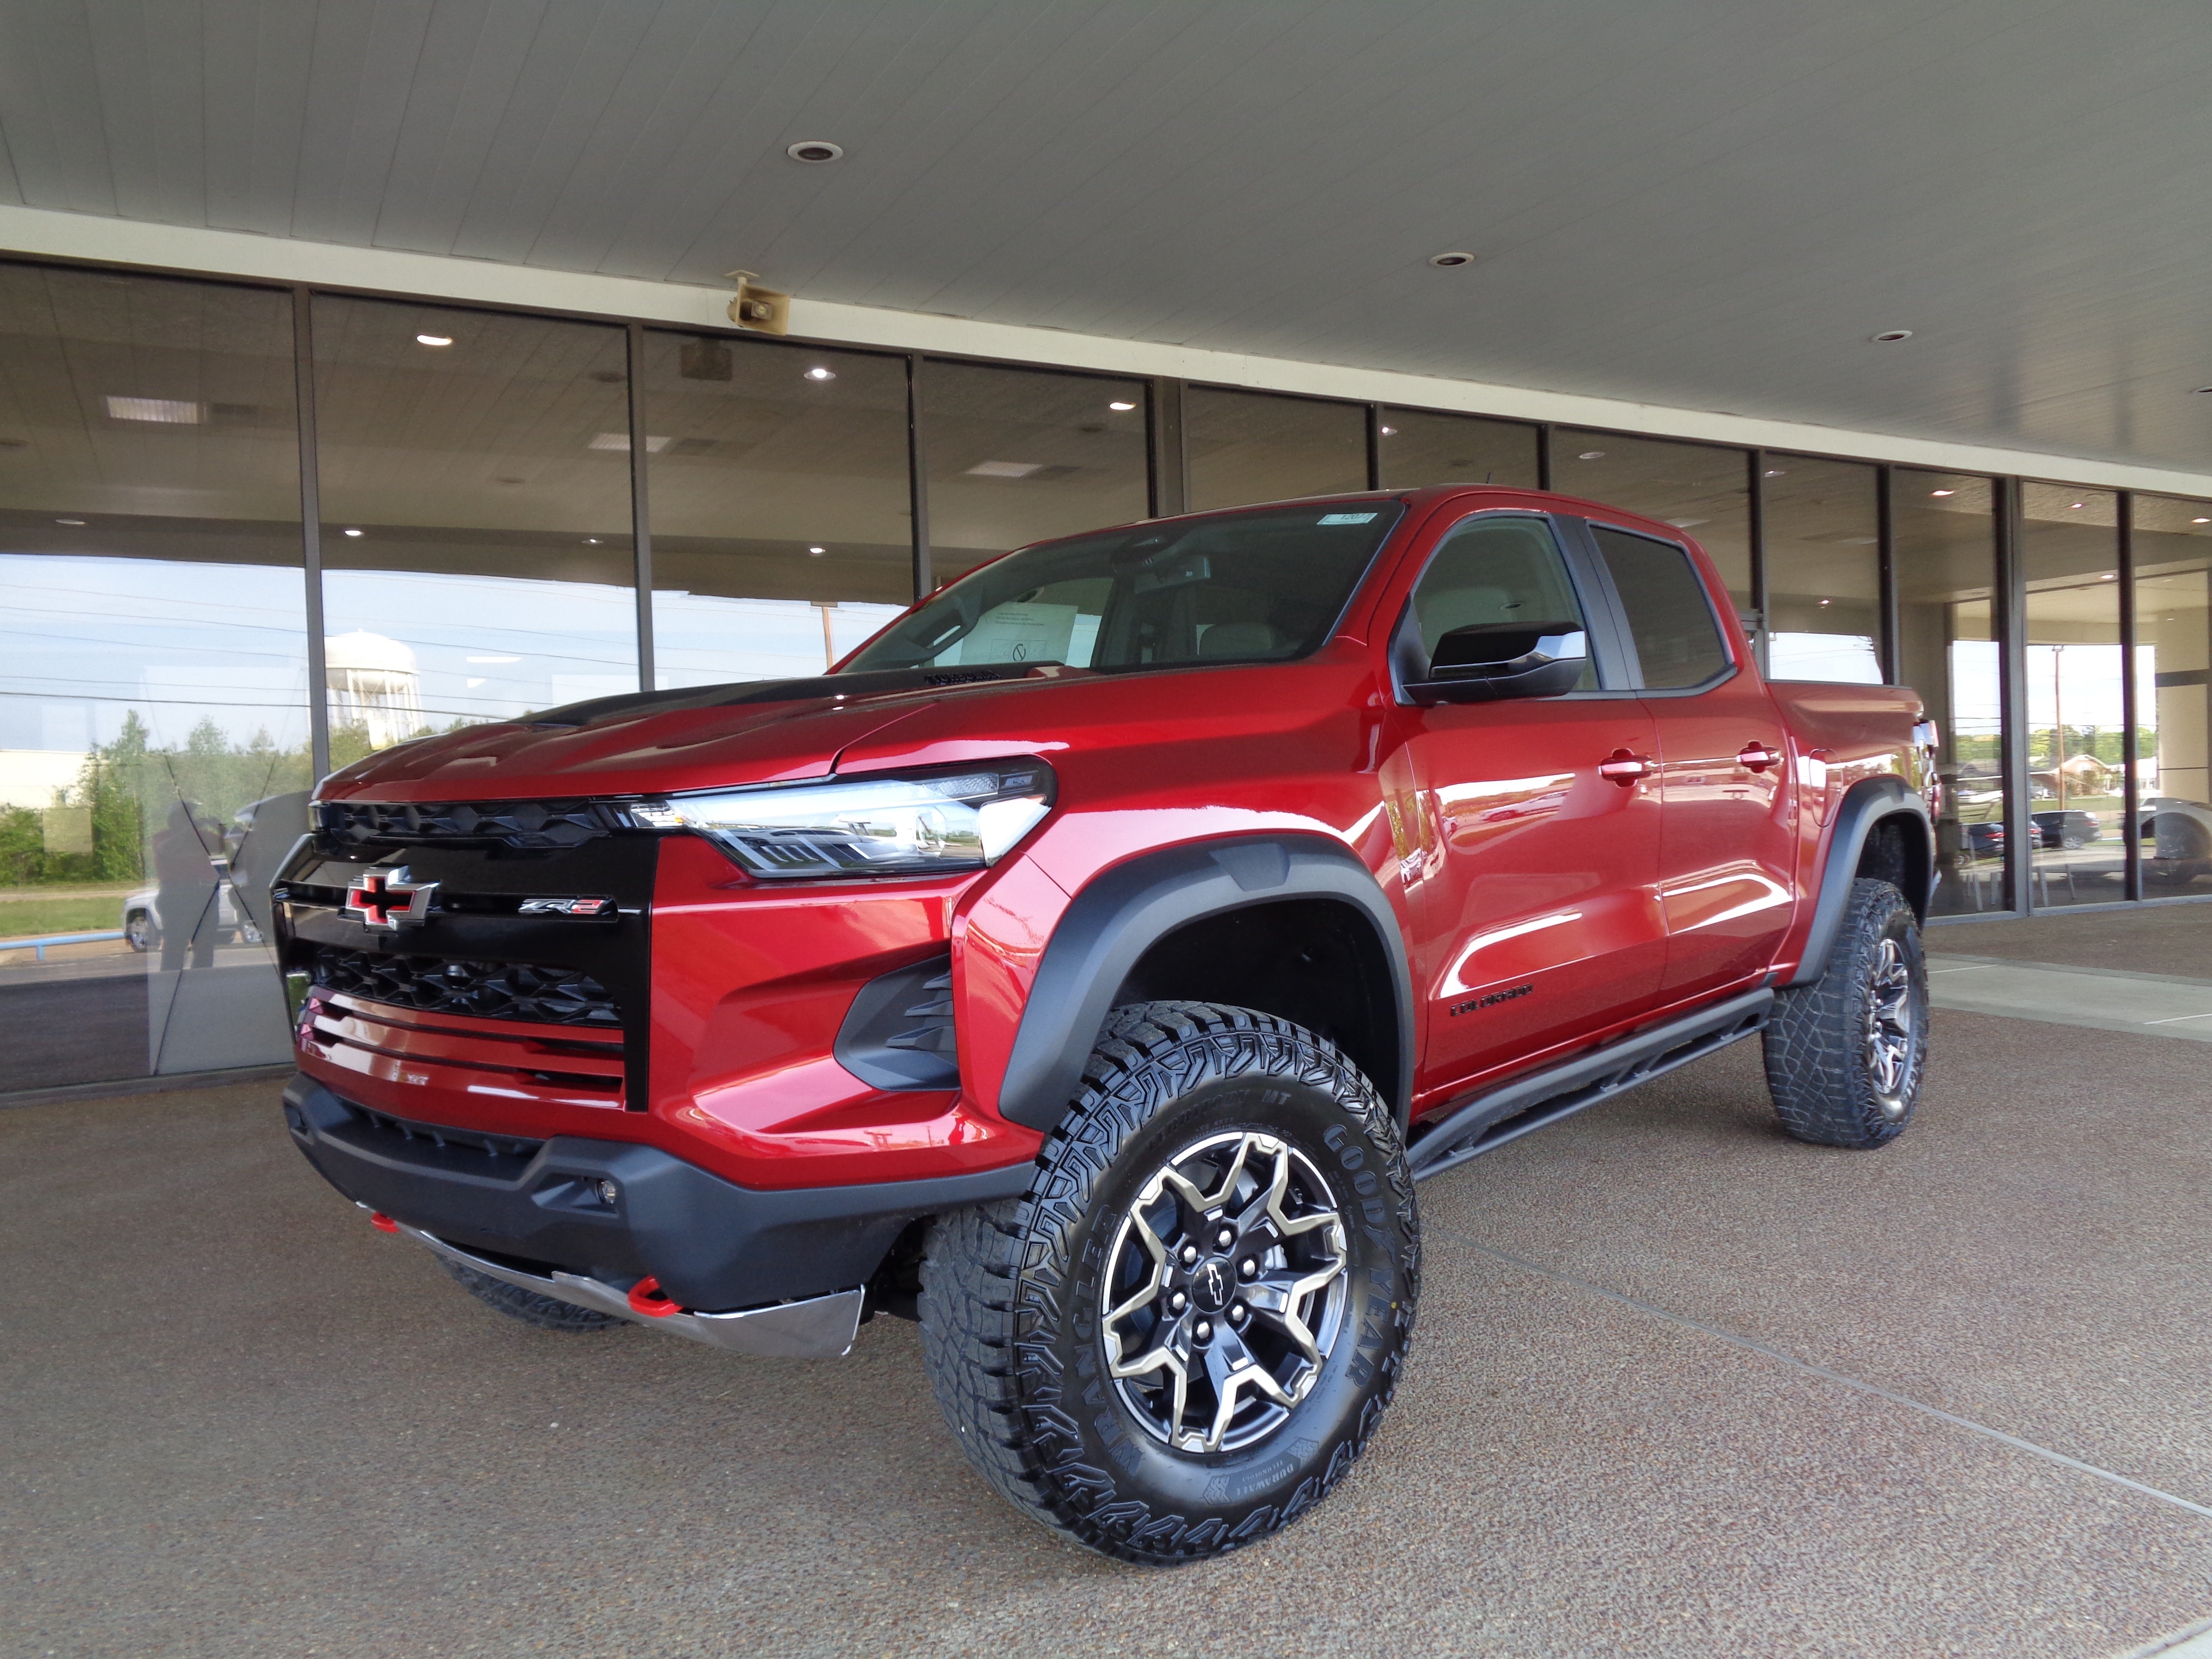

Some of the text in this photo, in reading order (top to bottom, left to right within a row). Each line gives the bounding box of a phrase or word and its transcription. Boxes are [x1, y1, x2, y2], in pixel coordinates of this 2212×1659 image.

[518, 898, 604, 915] ZR2
[1450, 983, 1534, 1017] COLORADO
[1073, 1204, 1143, 1478] WRANGLER
